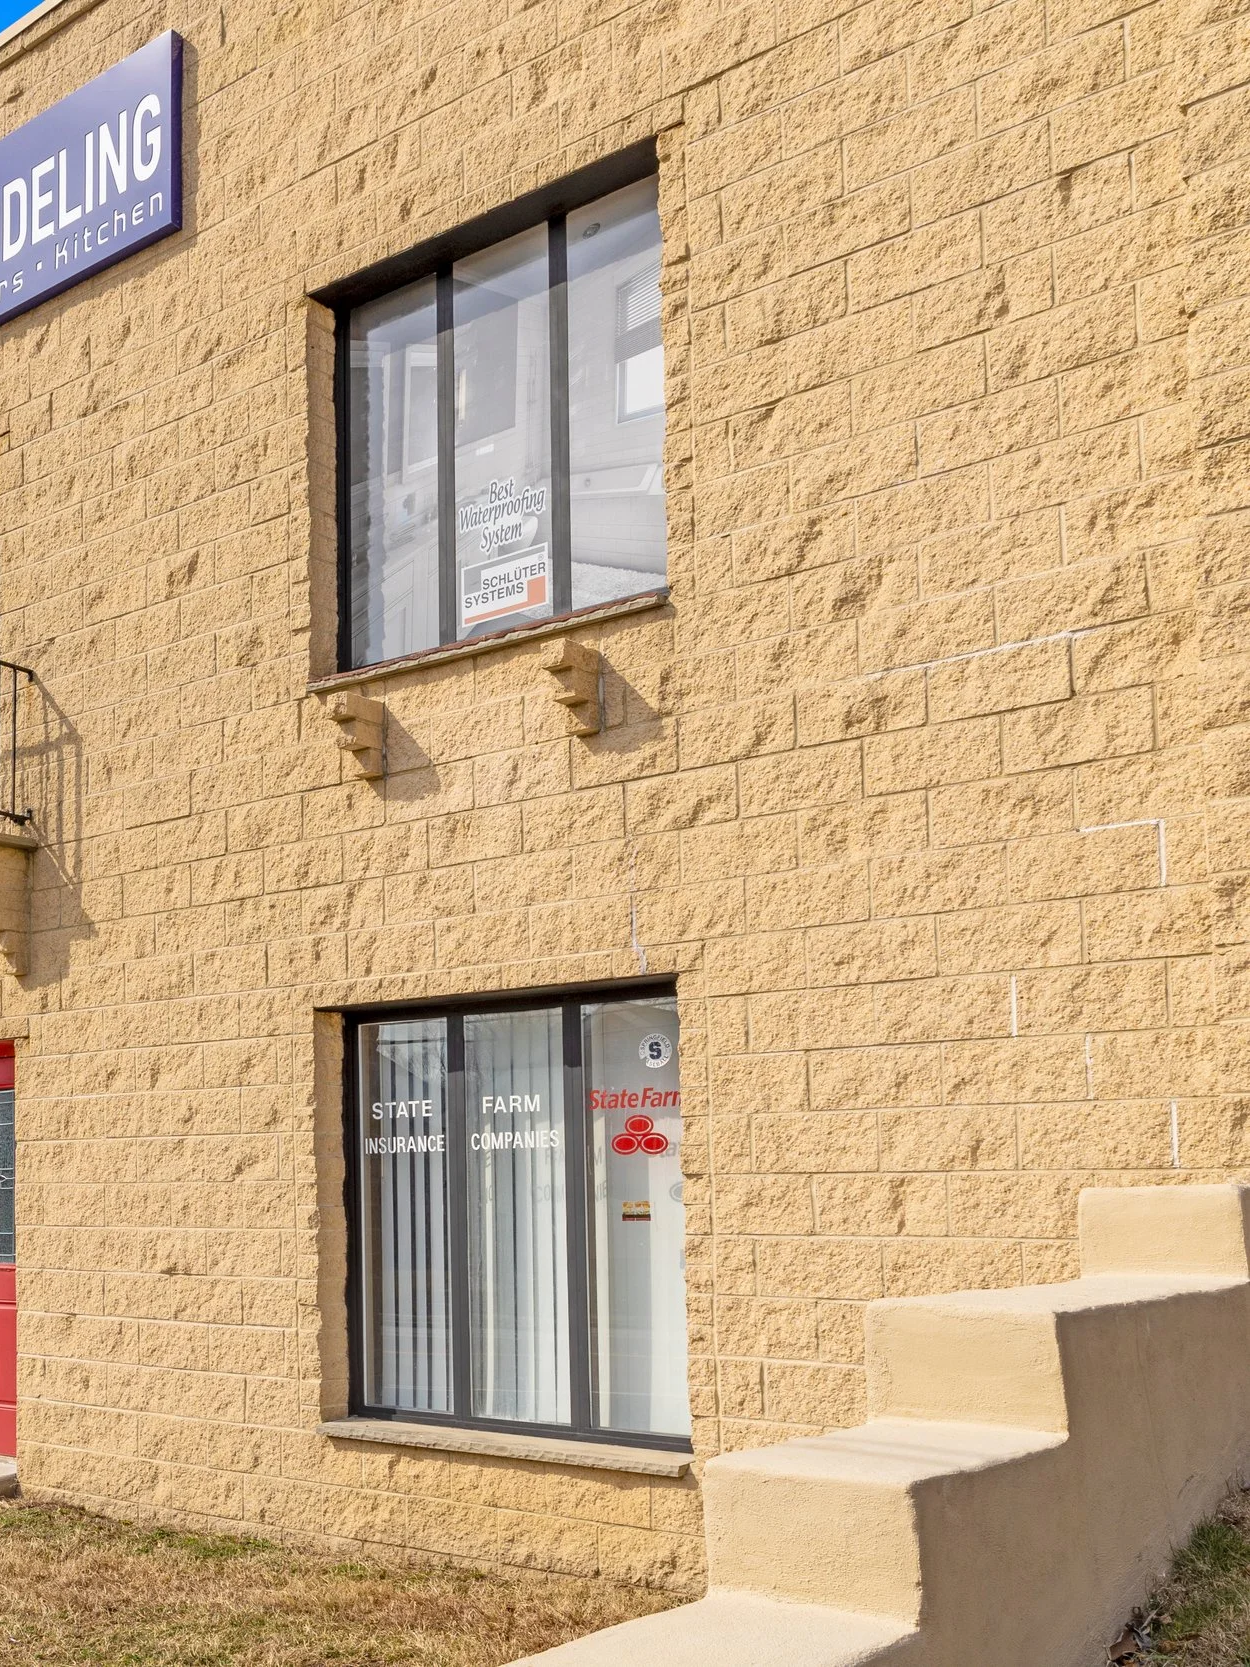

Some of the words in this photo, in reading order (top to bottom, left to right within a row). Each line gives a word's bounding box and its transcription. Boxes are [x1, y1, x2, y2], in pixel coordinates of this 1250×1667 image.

[54, 191, 163, 270] Kitchen
[489, 478, 515, 504] Best
[459, 488, 546, 531] Waterproofing
[480, 520, 523, 552] System
[481, 561, 547, 591] SCHLÜTER
[464, 582, 525, 609] SYSTEMS
[648, 1041, 662, 1060] S
[371, 1099, 433, 1120] STATE
[482, 1094, 541, 1114] FARM
[364, 1134, 445, 1155] INSURANCE
[470, 1130, 560, 1151] COMPANIES
